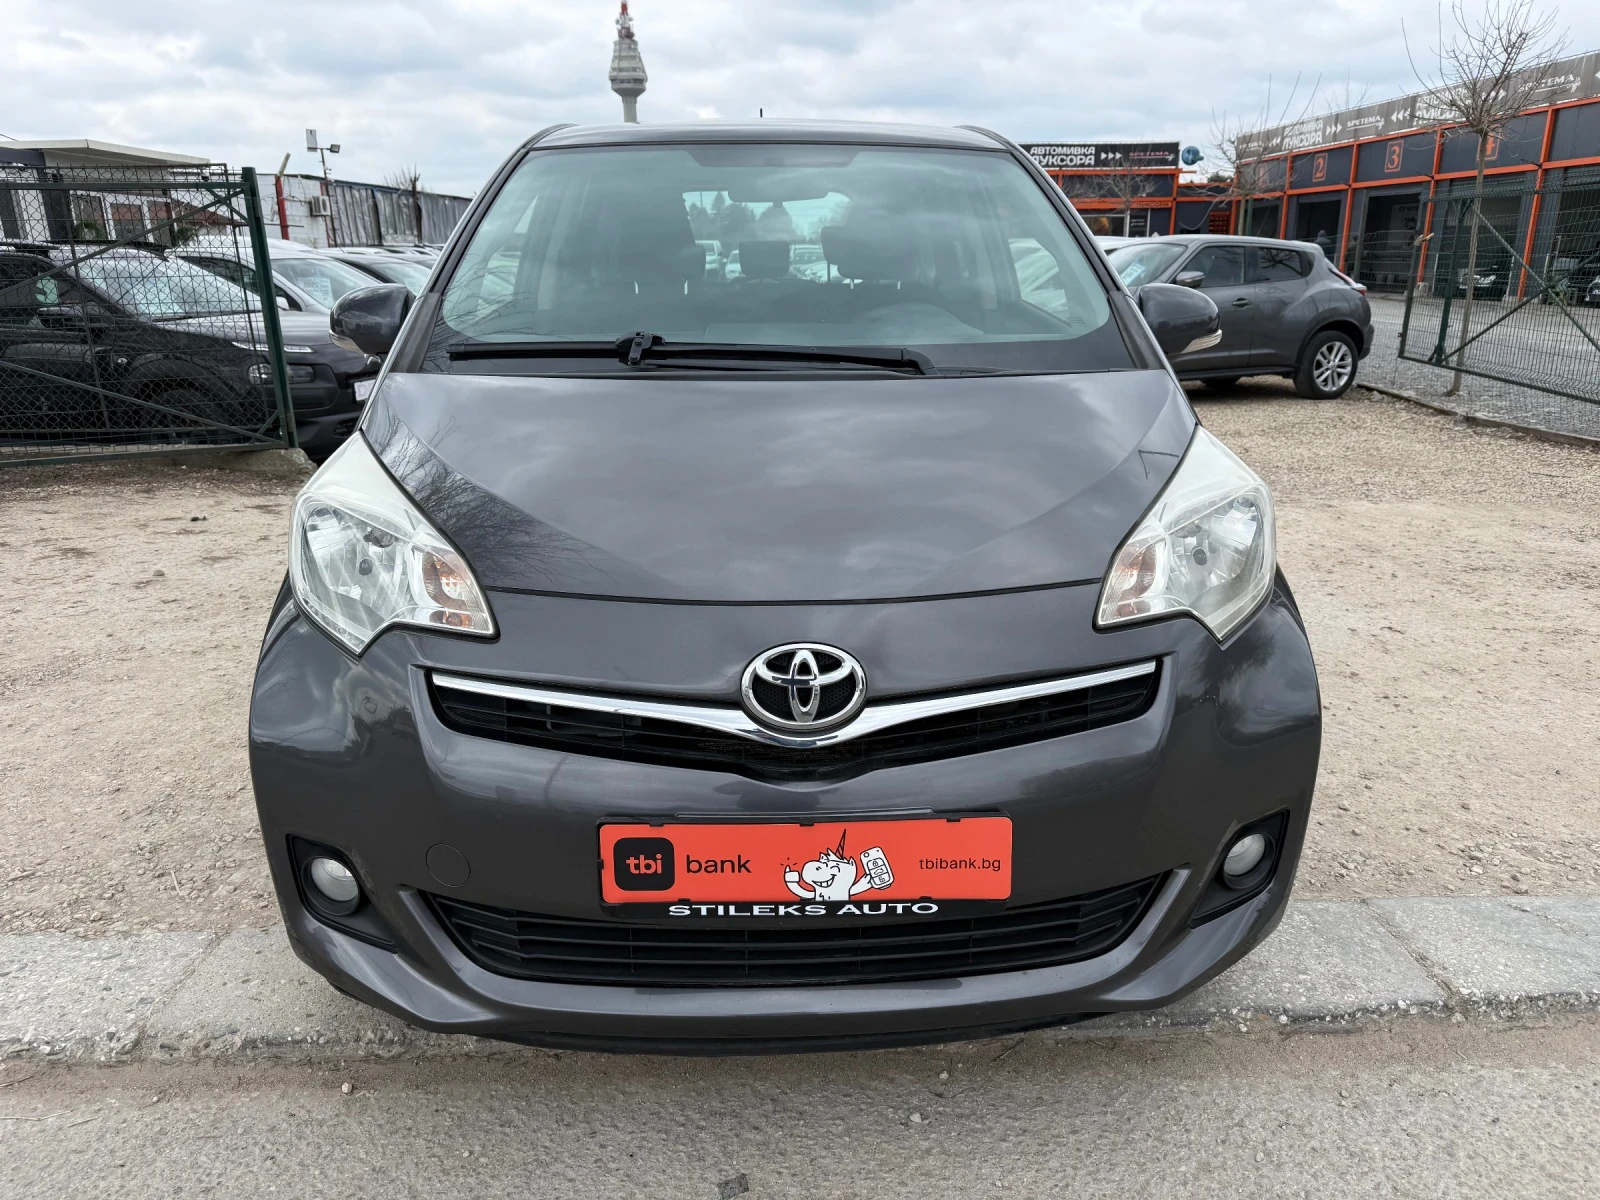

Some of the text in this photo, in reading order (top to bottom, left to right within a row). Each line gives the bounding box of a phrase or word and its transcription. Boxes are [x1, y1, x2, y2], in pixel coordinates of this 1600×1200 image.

[1347, 115, 1381, 127] SPETEMA
[1030, 146, 1096, 155] АВТОМИВКА
[1387, 145, 1400, 169] 3
[1314, 157, 1324, 178] 2
[626, 854, 752, 874] tbi bank
[919, 858, 1001, 871] tbibank.bg
[668, 902, 939, 916] STILEKS AUTO
